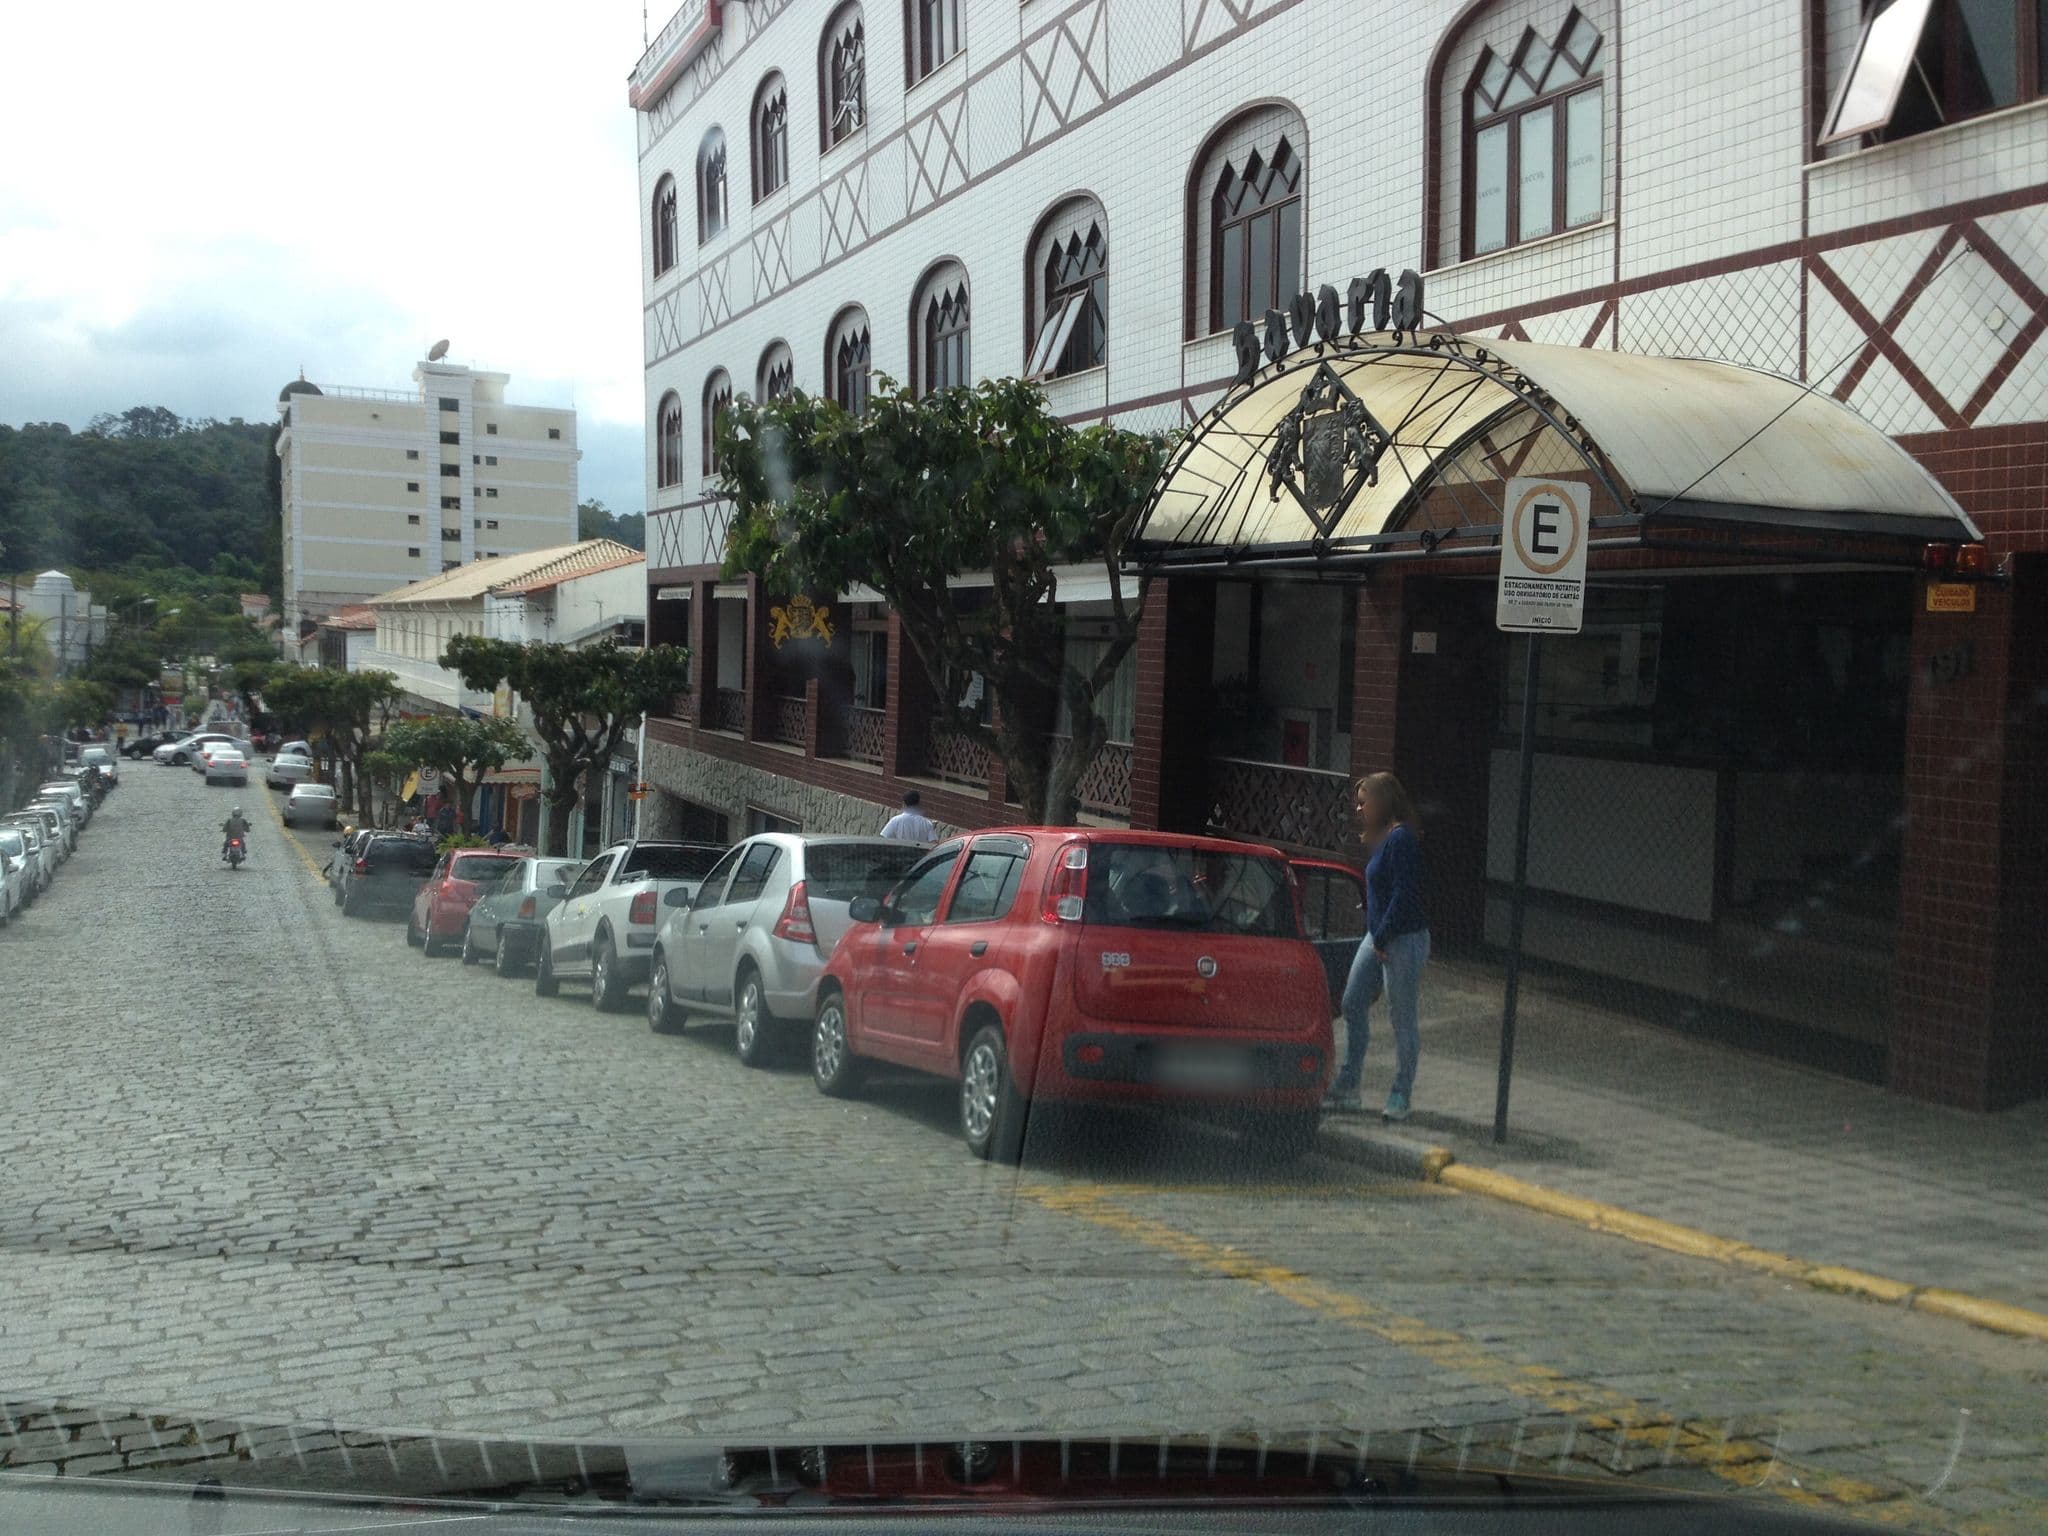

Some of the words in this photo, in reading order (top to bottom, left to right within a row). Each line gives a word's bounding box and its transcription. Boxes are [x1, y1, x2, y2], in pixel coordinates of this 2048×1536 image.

[1532, 504, 1560, 554] E
[1504, 581, 1554, 591] ESTACIONAMENTO
[1555, 584, 1580, 593] ROTATIVO
[425, 768, 432, 778] E
